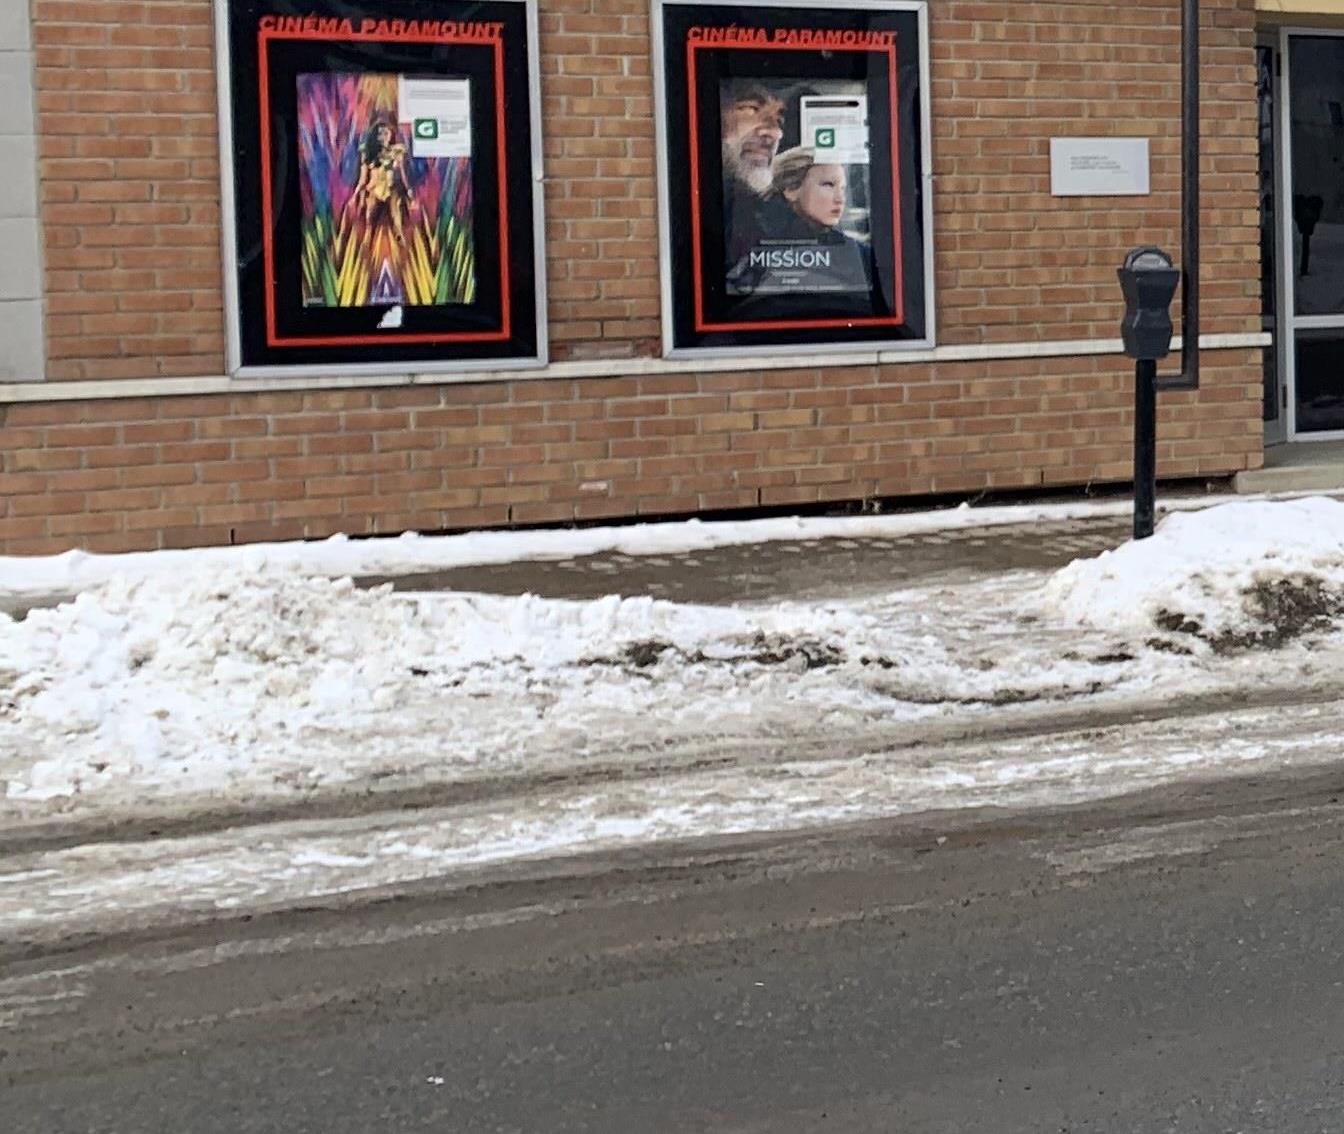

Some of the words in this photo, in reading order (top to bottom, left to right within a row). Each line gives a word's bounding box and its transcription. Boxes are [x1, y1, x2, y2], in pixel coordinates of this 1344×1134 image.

[259, 12, 354, 34] CINÉMA
[360, 17, 504, 39] PARAMOUNT
[687, 22, 768, 43] CINÉMA
[773, 28, 898, 46] PARAMOUNT
[749, 249, 831, 268] MISSION
